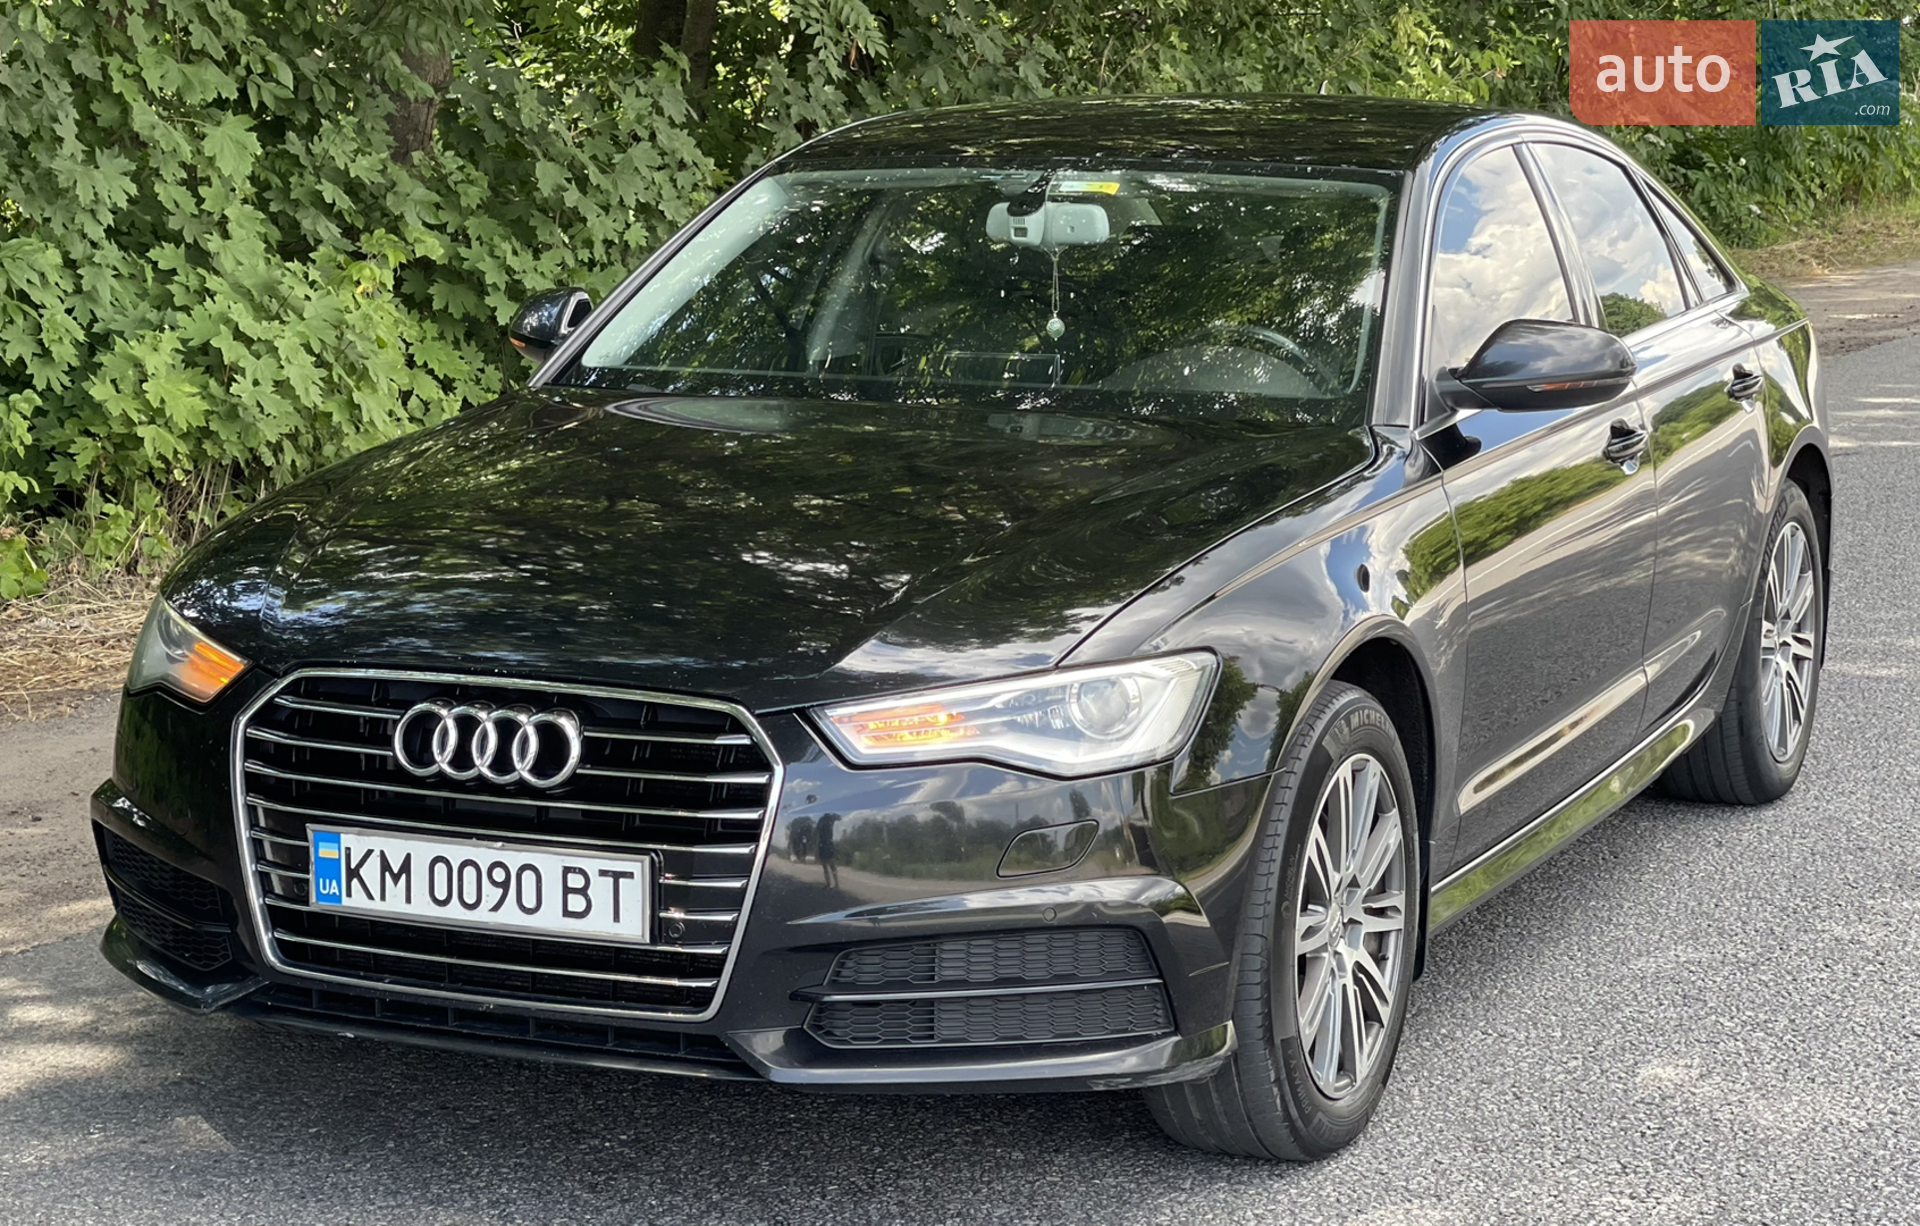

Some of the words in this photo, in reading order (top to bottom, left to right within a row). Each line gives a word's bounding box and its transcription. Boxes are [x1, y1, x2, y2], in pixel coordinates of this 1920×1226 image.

[319, 878, 340, 896] UA
[344, 846, 412, 904] KM
[428, 854, 544, 915] 0090
[561, 865, 635, 924] BT
